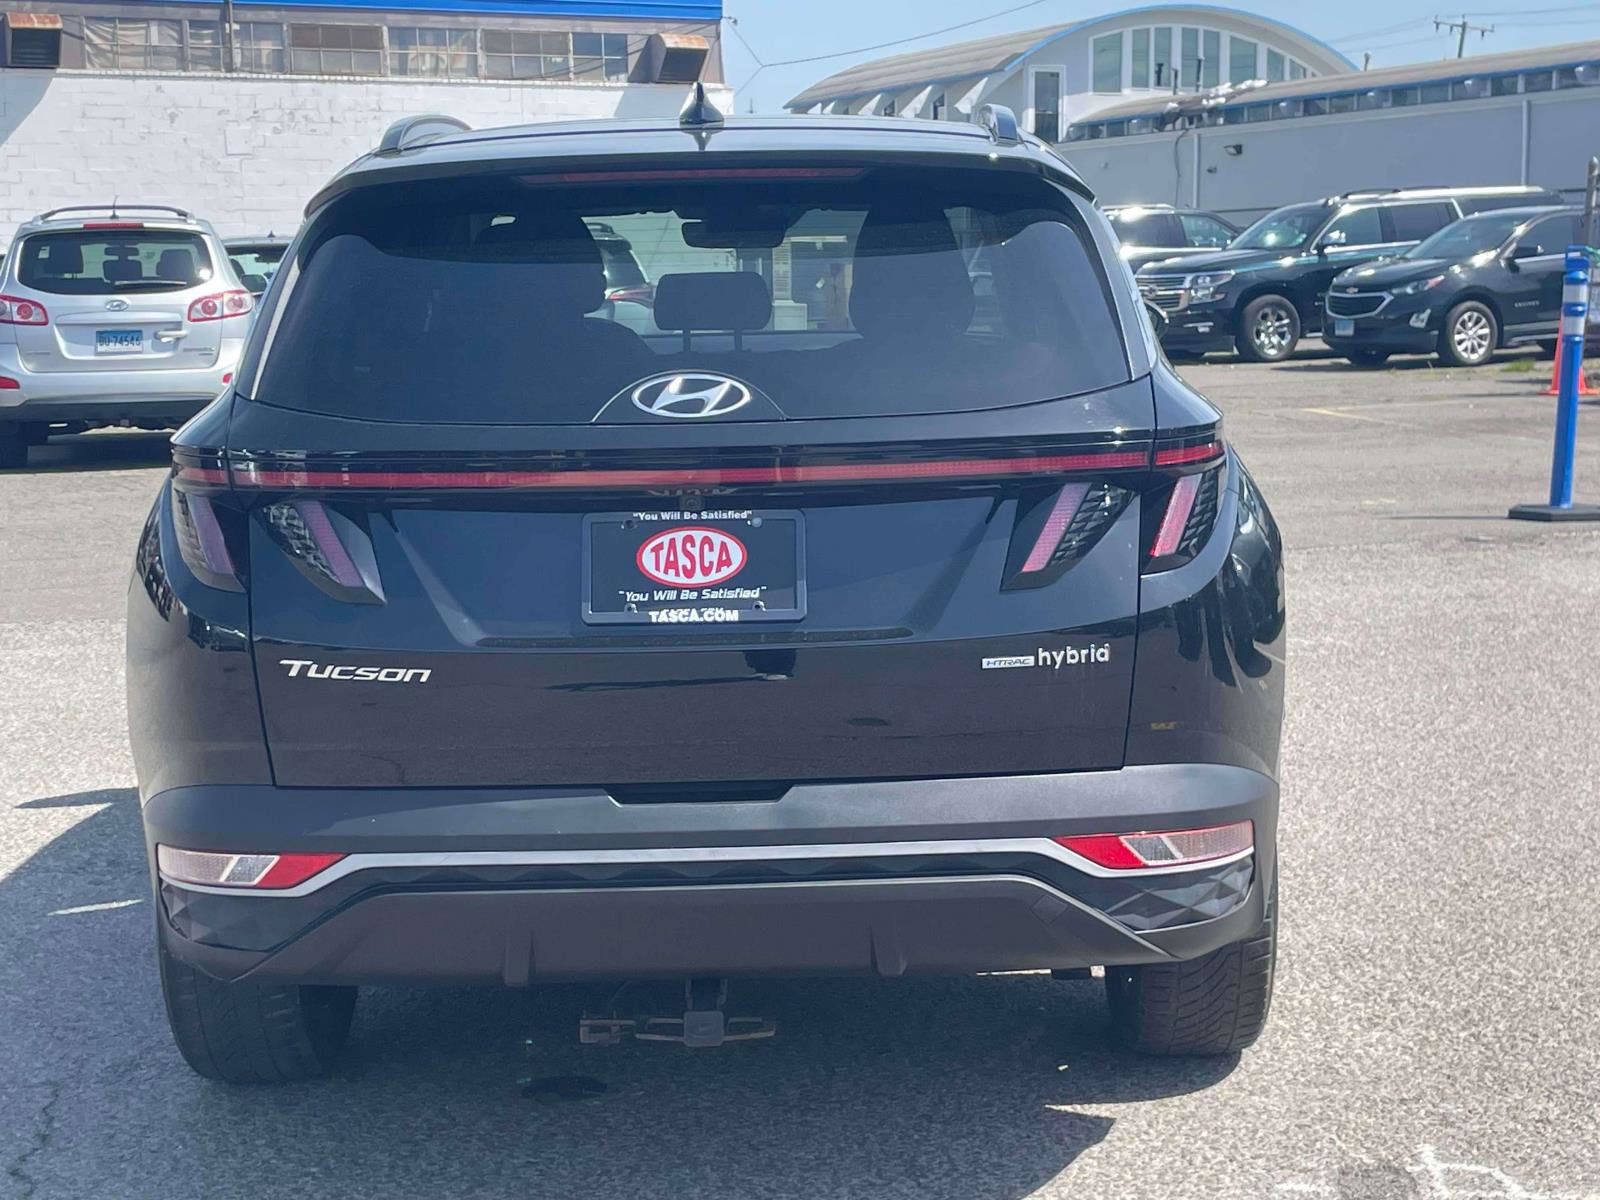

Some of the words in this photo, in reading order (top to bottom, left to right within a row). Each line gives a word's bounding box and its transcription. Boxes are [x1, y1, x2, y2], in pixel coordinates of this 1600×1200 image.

[633, 512, 658, 521] "You
[660, 511, 680, 520] Will
[684, 511, 698, 520] Be
[701, 510, 752, 520] Satisfied"
[650, 534, 733, 579] TASCA
[619, 590, 648, 601] "You
[653, 590, 677, 601] Will
[680, 589, 698, 600] Be
[701, 586, 767, 599] Satisfied"
[648, 608, 739, 623] TASCA.COM
[1037, 643, 1111, 669] hybrid
[279, 659, 432, 683] Tucson
